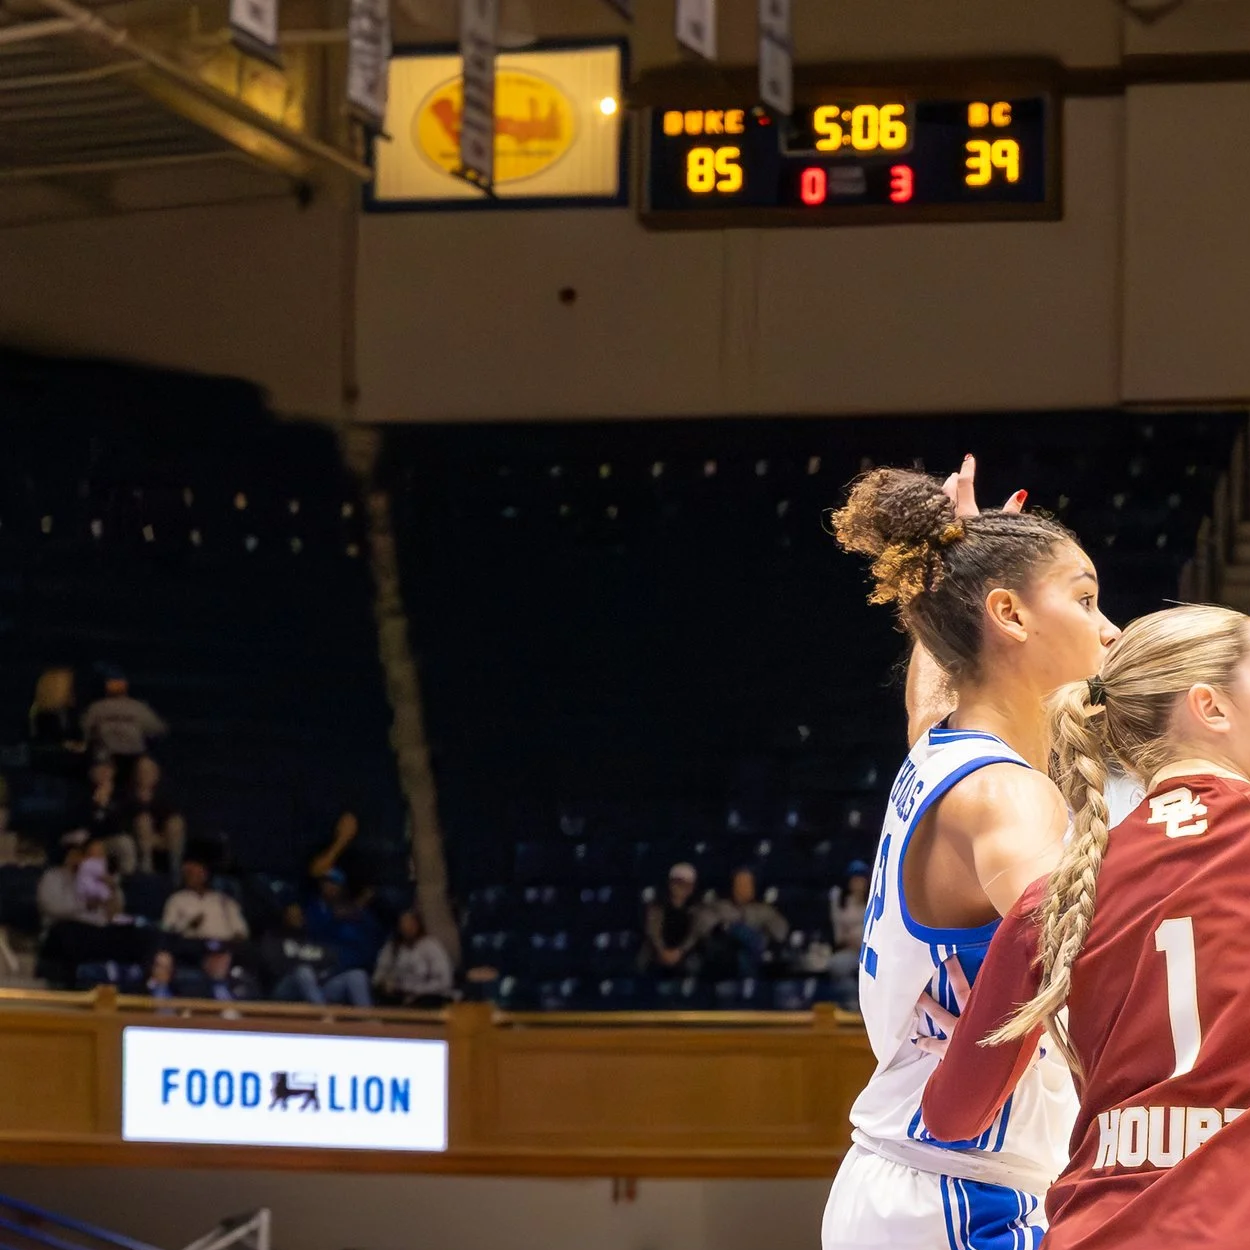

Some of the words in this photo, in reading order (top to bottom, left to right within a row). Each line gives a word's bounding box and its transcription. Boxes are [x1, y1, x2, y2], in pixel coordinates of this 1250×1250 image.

[662, 109, 746, 137] DUKE
[812, 103, 907, 152] 5:06
[685, 145, 743, 194] 85
[800, 166, 828, 206] 0
[888, 164, 915, 203] 3
[964, 138, 1021, 188] 39
[1153, 915, 1203, 1080] 1
[160, 1067, 262, 1108] FOOD
[328, 1075, 412, 1114] LION
[1091, 1105, 1250, 1170] HOUR
